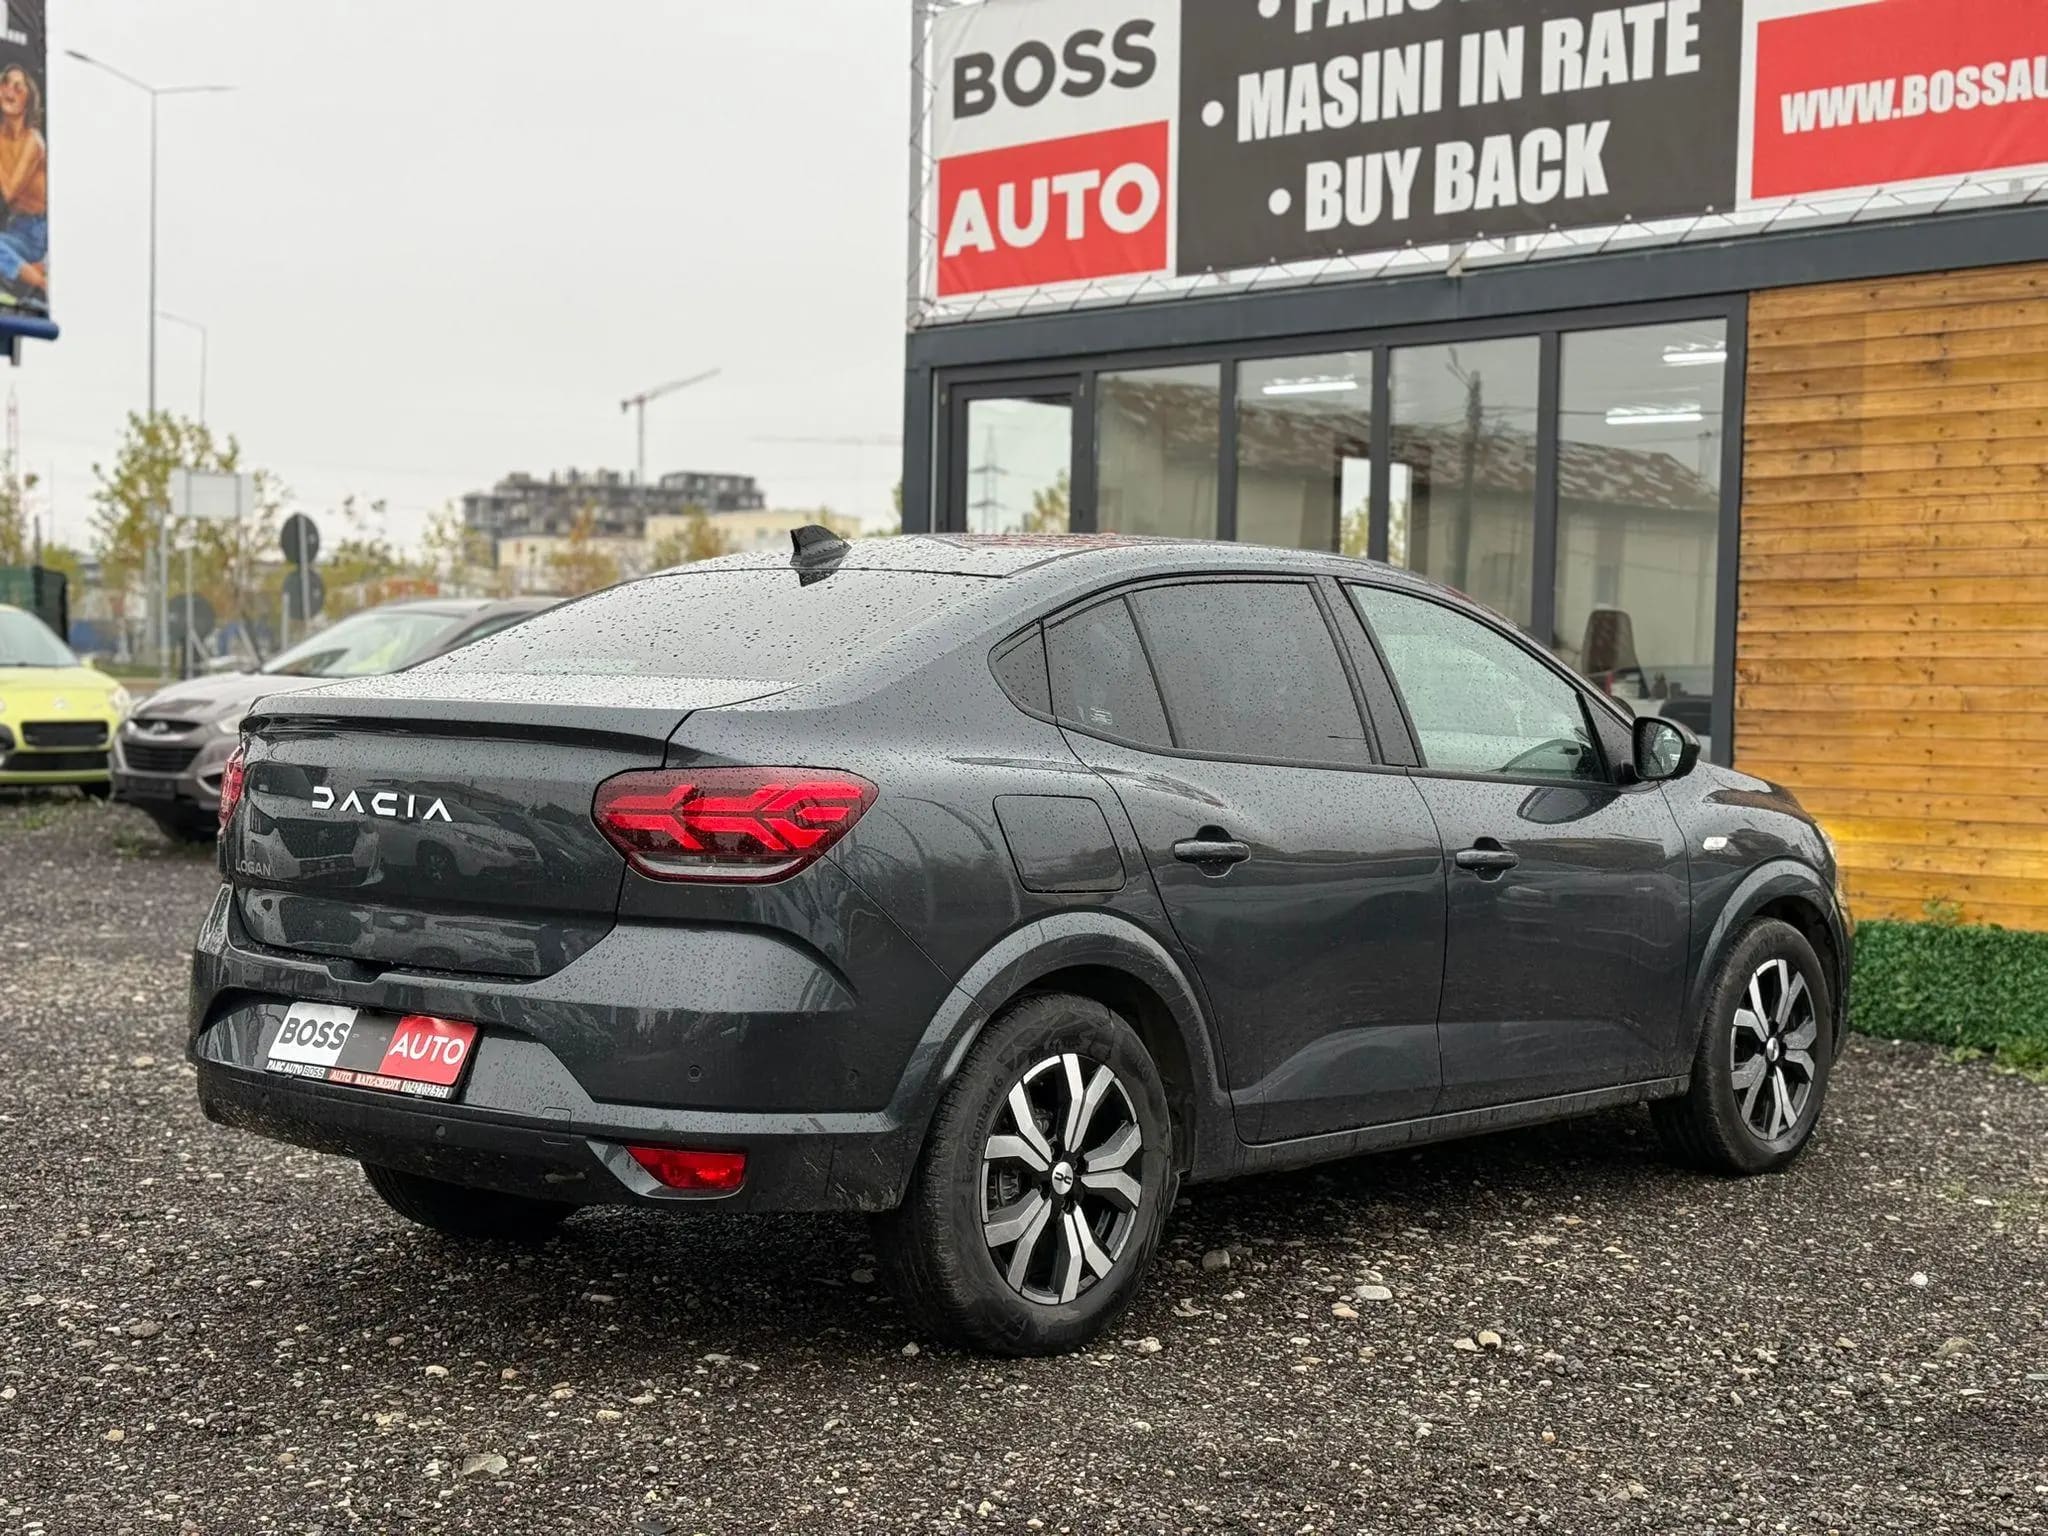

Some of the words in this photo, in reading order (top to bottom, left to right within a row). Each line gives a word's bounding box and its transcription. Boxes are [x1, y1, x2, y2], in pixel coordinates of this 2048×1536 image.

[953, 19, 1157, 121] BOSS
[1237, 39, 1444, 143] MASINI
[1459, 26, 1525, 107] IN
[1541, 0, 1700, 96] RATE
[942, 162, 1161, 258] AUTO
[1305, 147, 1421, 232] BUY
[1434, 120, 1611, 215] BACK
[311, 785, 453, 823] DACIA
[235, 858, 271, 877] LOGAN
[278, 1017, 350, 1051] BOSS
[388, 1031, 466, 1065] AUTO
[283, 1063, 305, 1076] AUTO
[303, 1065, 324, 1078] BOSS
